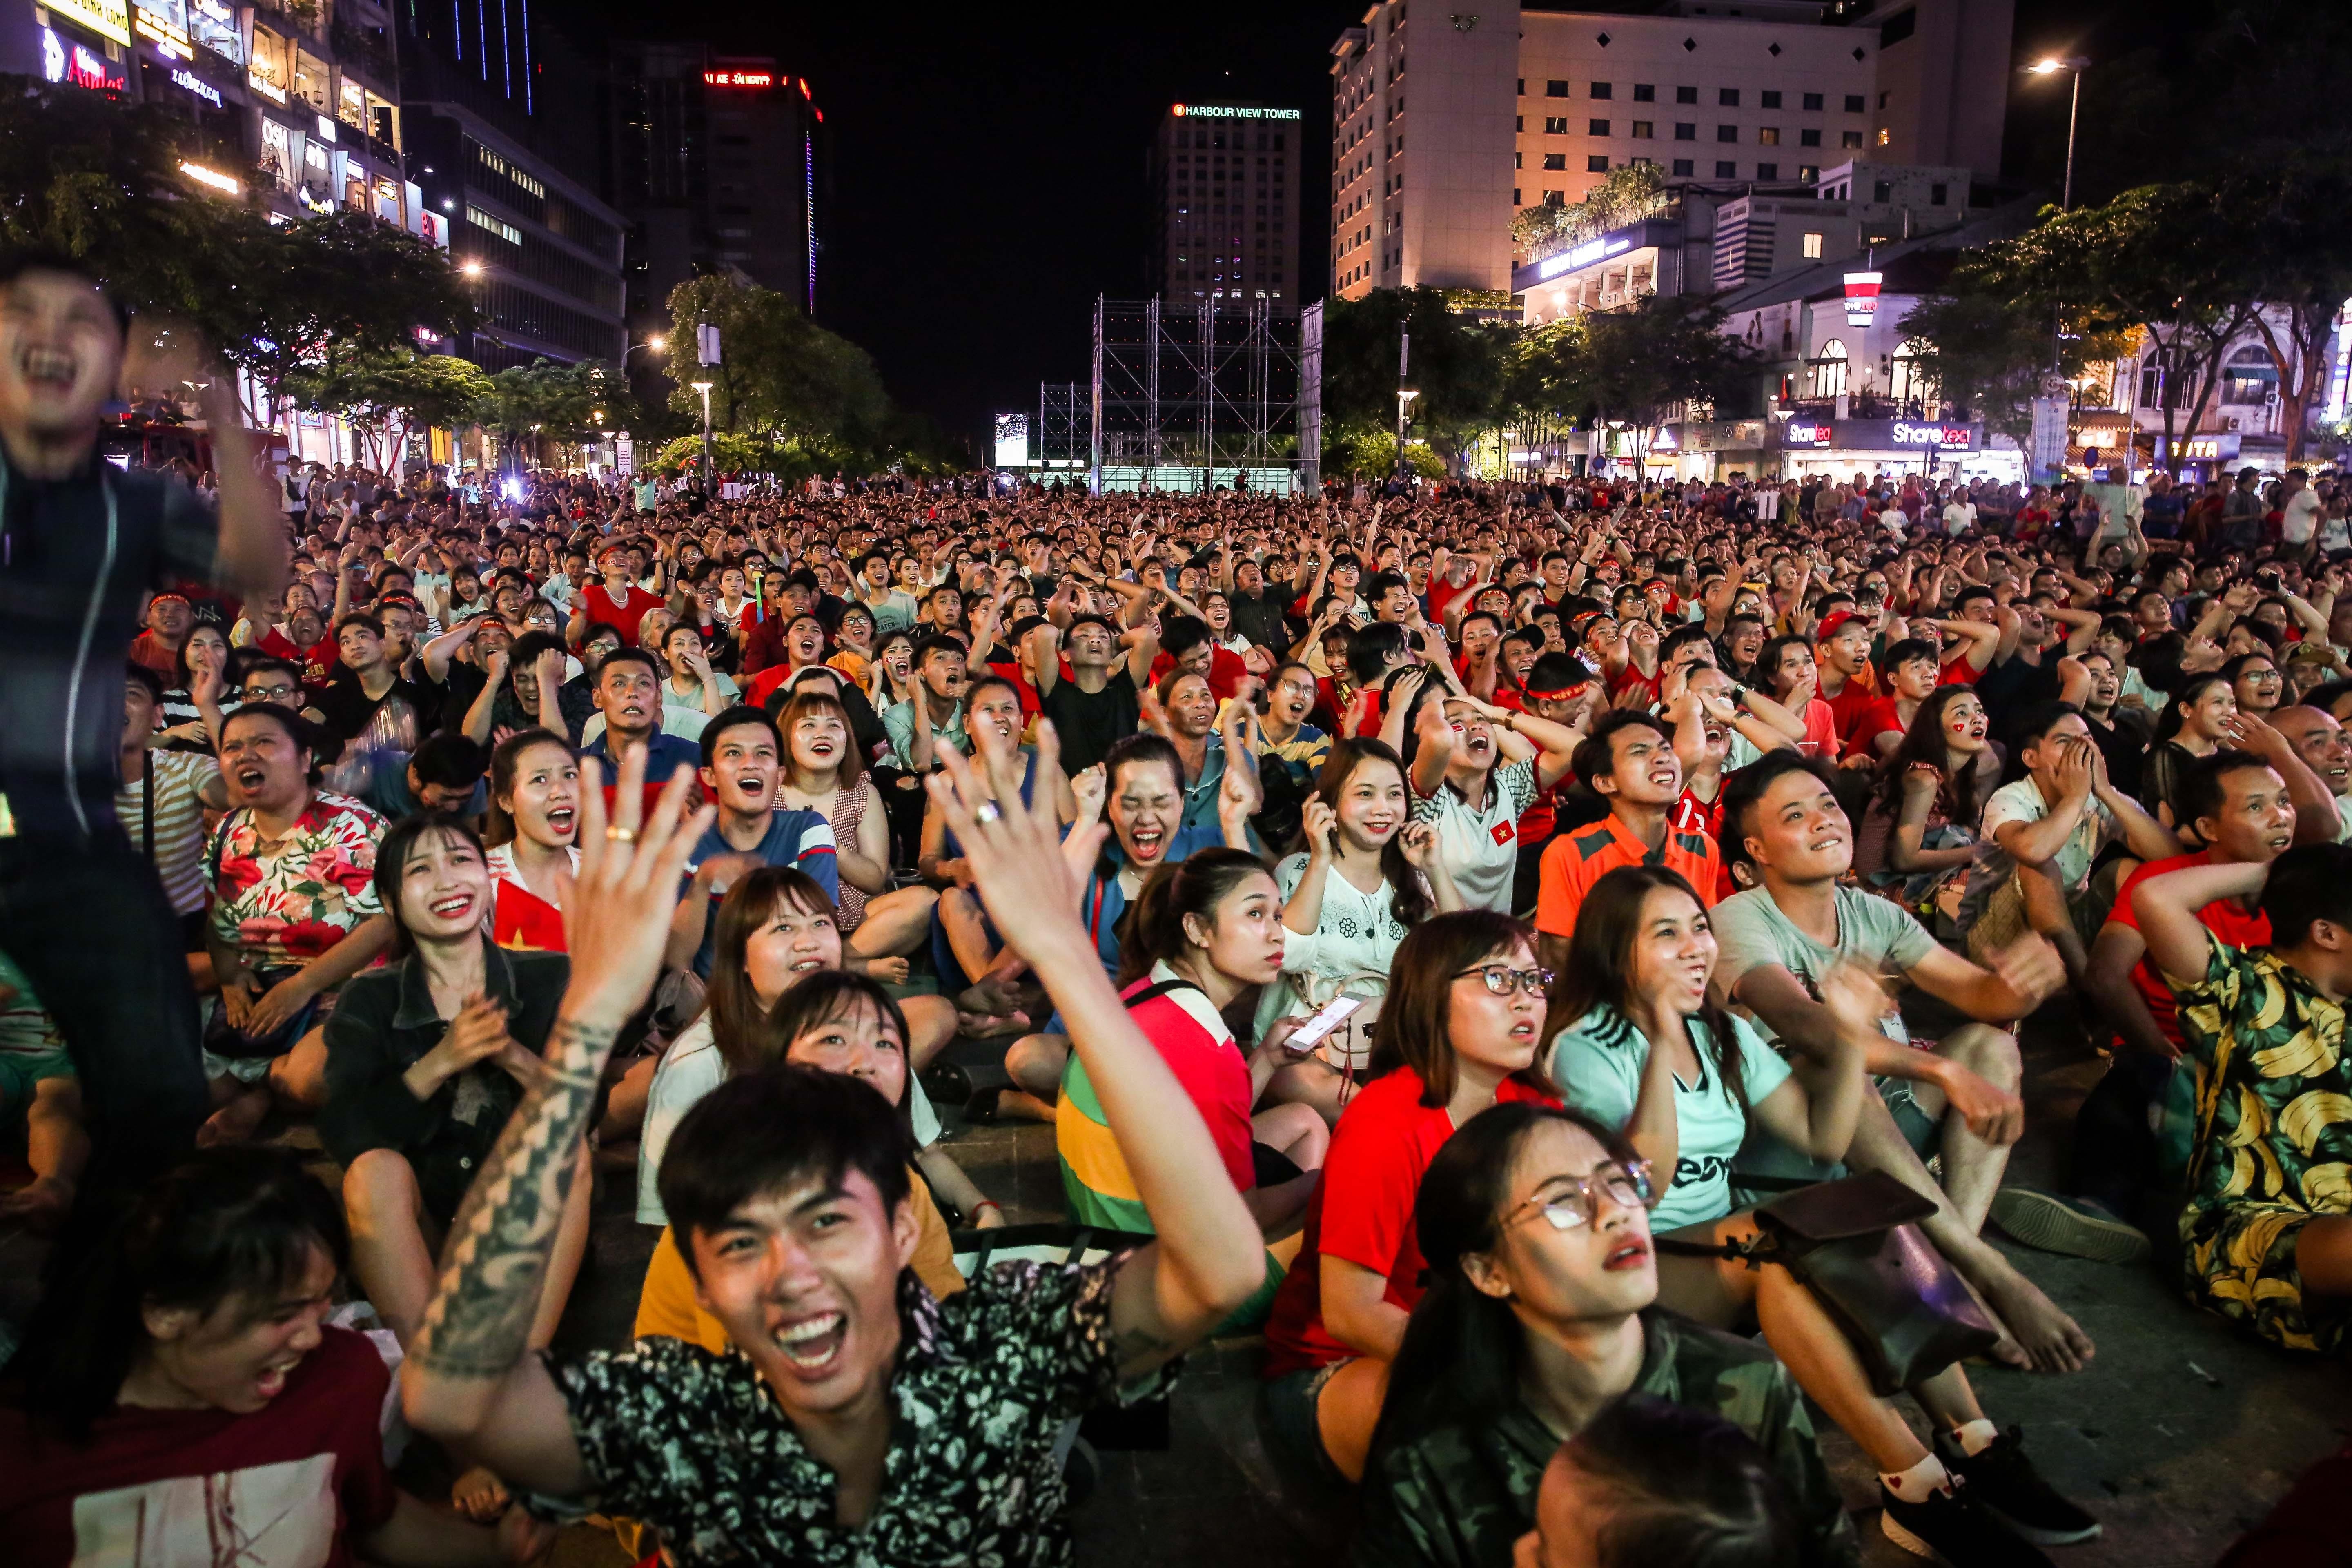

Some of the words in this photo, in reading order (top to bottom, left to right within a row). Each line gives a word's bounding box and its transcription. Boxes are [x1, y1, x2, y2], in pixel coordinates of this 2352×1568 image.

[105, 6, 127, 31] LONG
[1185, 106, 1234, 117] HARBOUR
[1236, 108, 1262, 118] VIEW
[1263, 109, 1300, 119] TOWER
[1789, 423, 1831, 442] Sharetea
[1893, 423, 1971, 443] Sharetea
